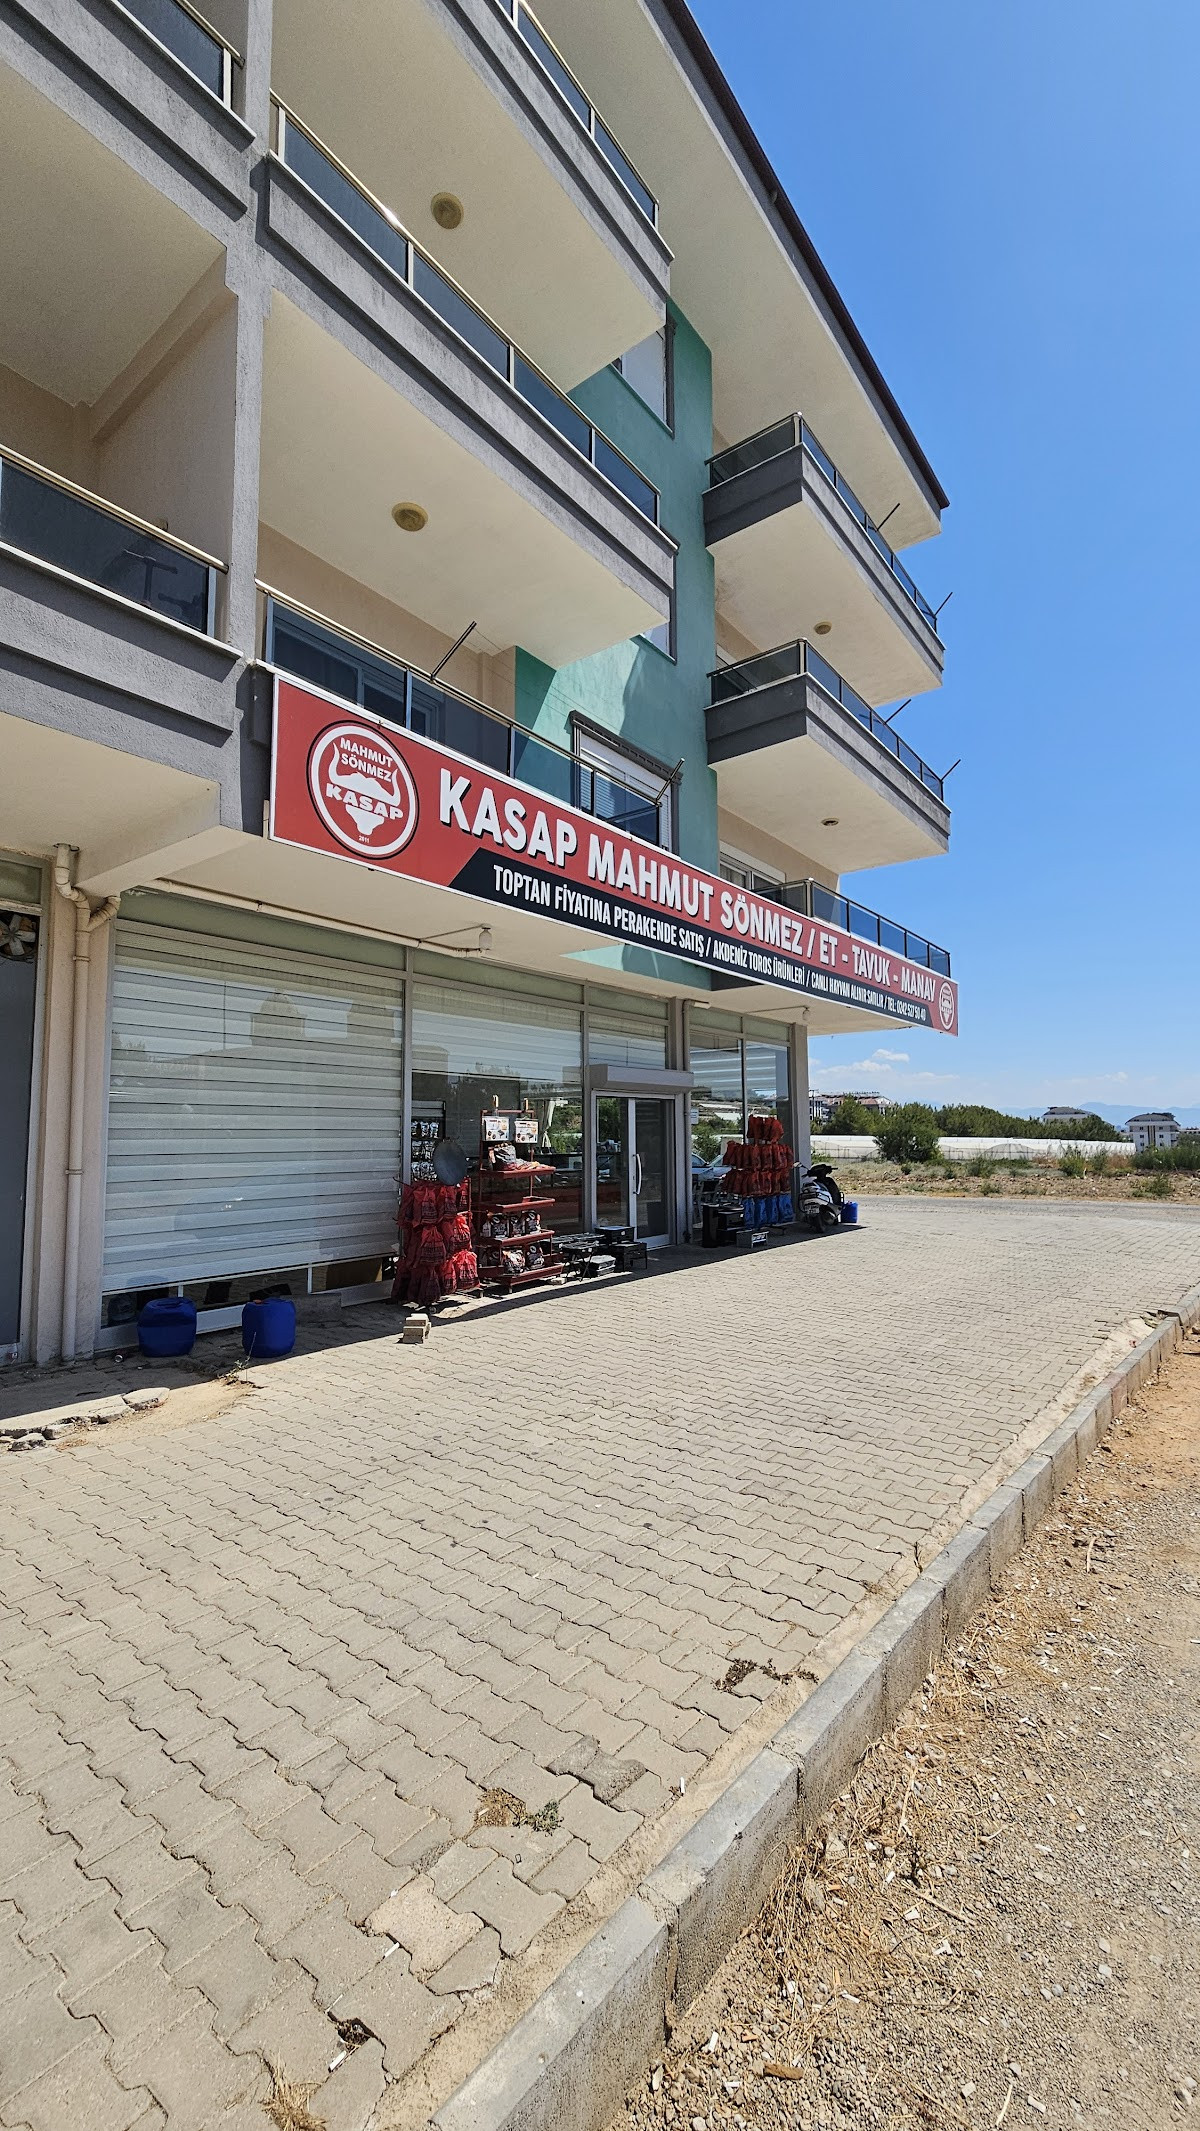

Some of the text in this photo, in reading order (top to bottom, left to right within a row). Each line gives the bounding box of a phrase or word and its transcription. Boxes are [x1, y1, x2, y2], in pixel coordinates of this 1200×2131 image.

[340, 737, 394, 768] MAHMUT
[341, 753, 393, 782] SÖNMEZ
[326, 783, 404, 820] KASAP
[440, 768, 578, 867] KASAP
[588, 833, 714, 922] MAHMUT
[720, 891, 803, 955] SÖNMEZ
[807, 928, 816, 958] /
[820, 931, 838, 966] ET
[852, 944, 891, 986] TAVUK
[901, 967, 936, 1002] MANAV
[493, 865, 550, 906] TOPTAN
[555, 883, 611, 926] FİYATINA
[614, 906, 677, 946] PERAKENDE
[679, 927, 705, 958] SATIŞ
[705, 936, 711, 957] /
[713, 940, 748, 968] AKDENİZ
[748, 952, 772, 976] TOROS
[773, 957, 805, 986] ÜRÜNLERİ
[811, 972, 829, 992] CANLI
[829, 977, 850, 998] HAYVAN
